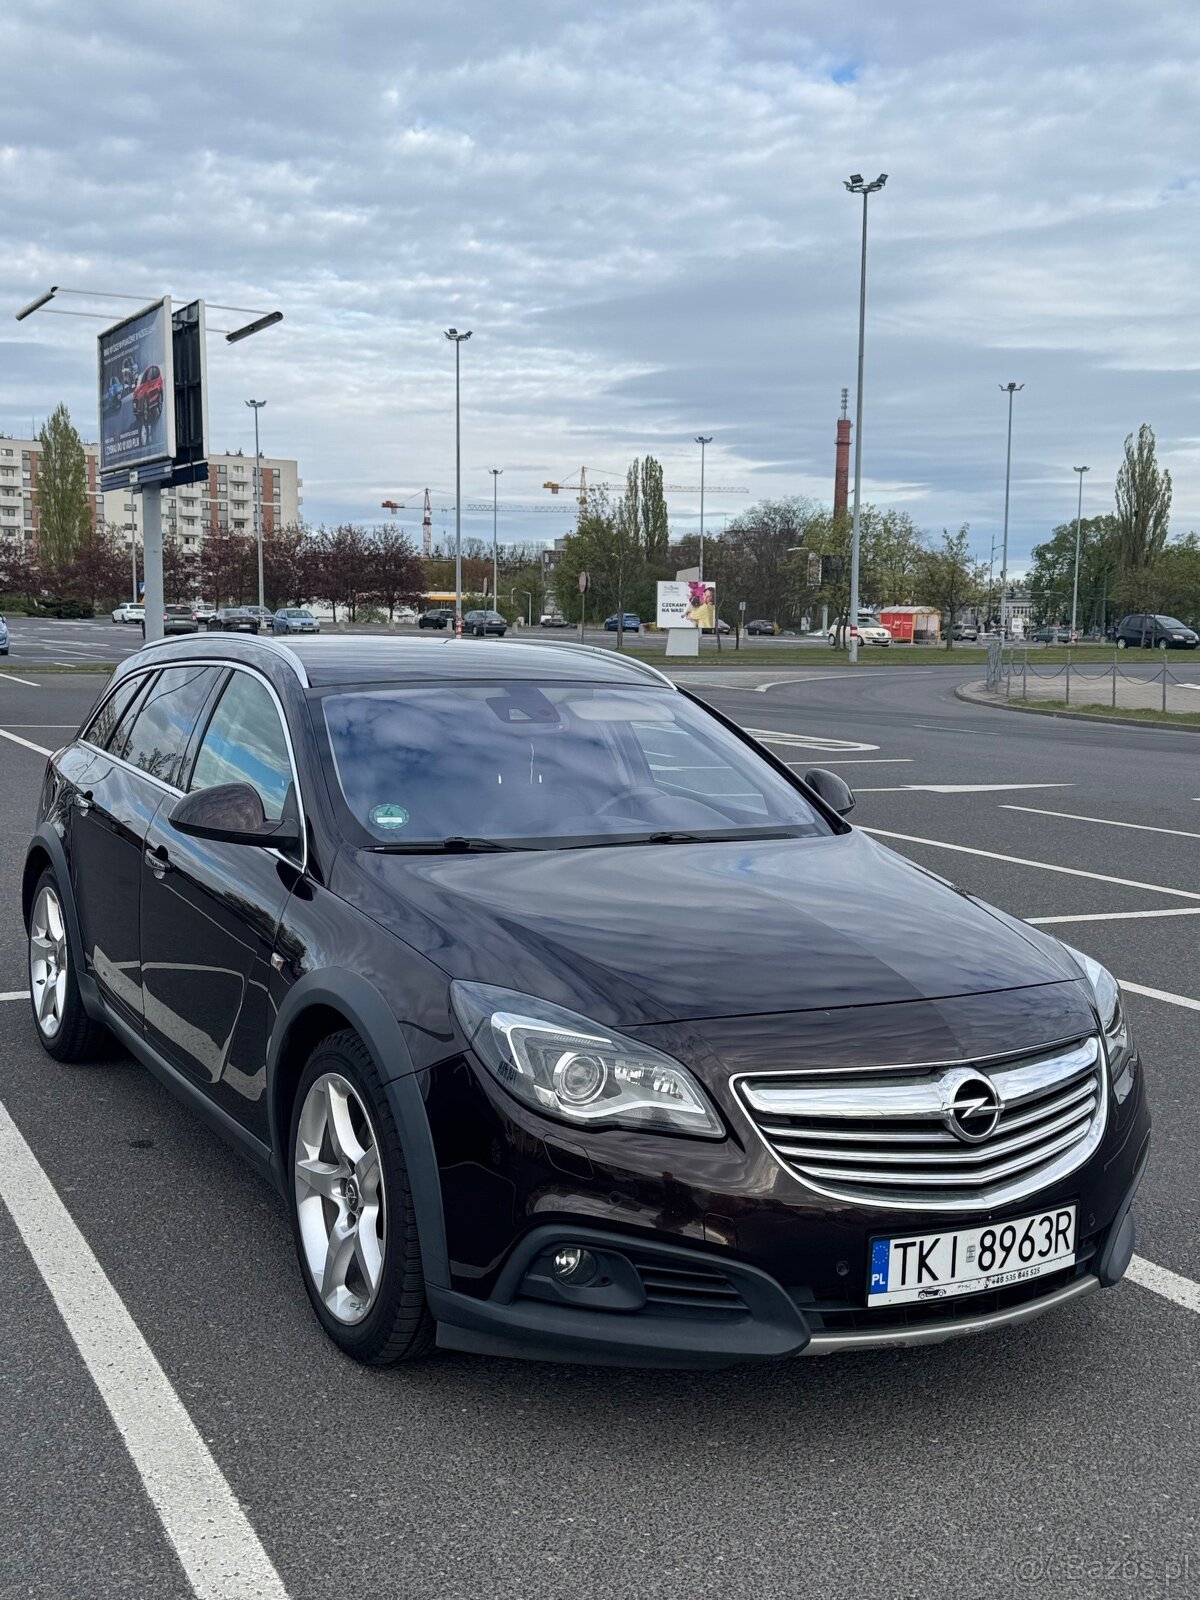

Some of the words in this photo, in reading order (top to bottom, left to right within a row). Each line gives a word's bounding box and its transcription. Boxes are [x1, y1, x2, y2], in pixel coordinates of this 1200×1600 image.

[384, 808, 393, 816] 4
[977, 1210, 1072, 1272] 8963R
[871, 1273, 886, 1286] PL
[1005, 1273, 1016, 1283] 535
